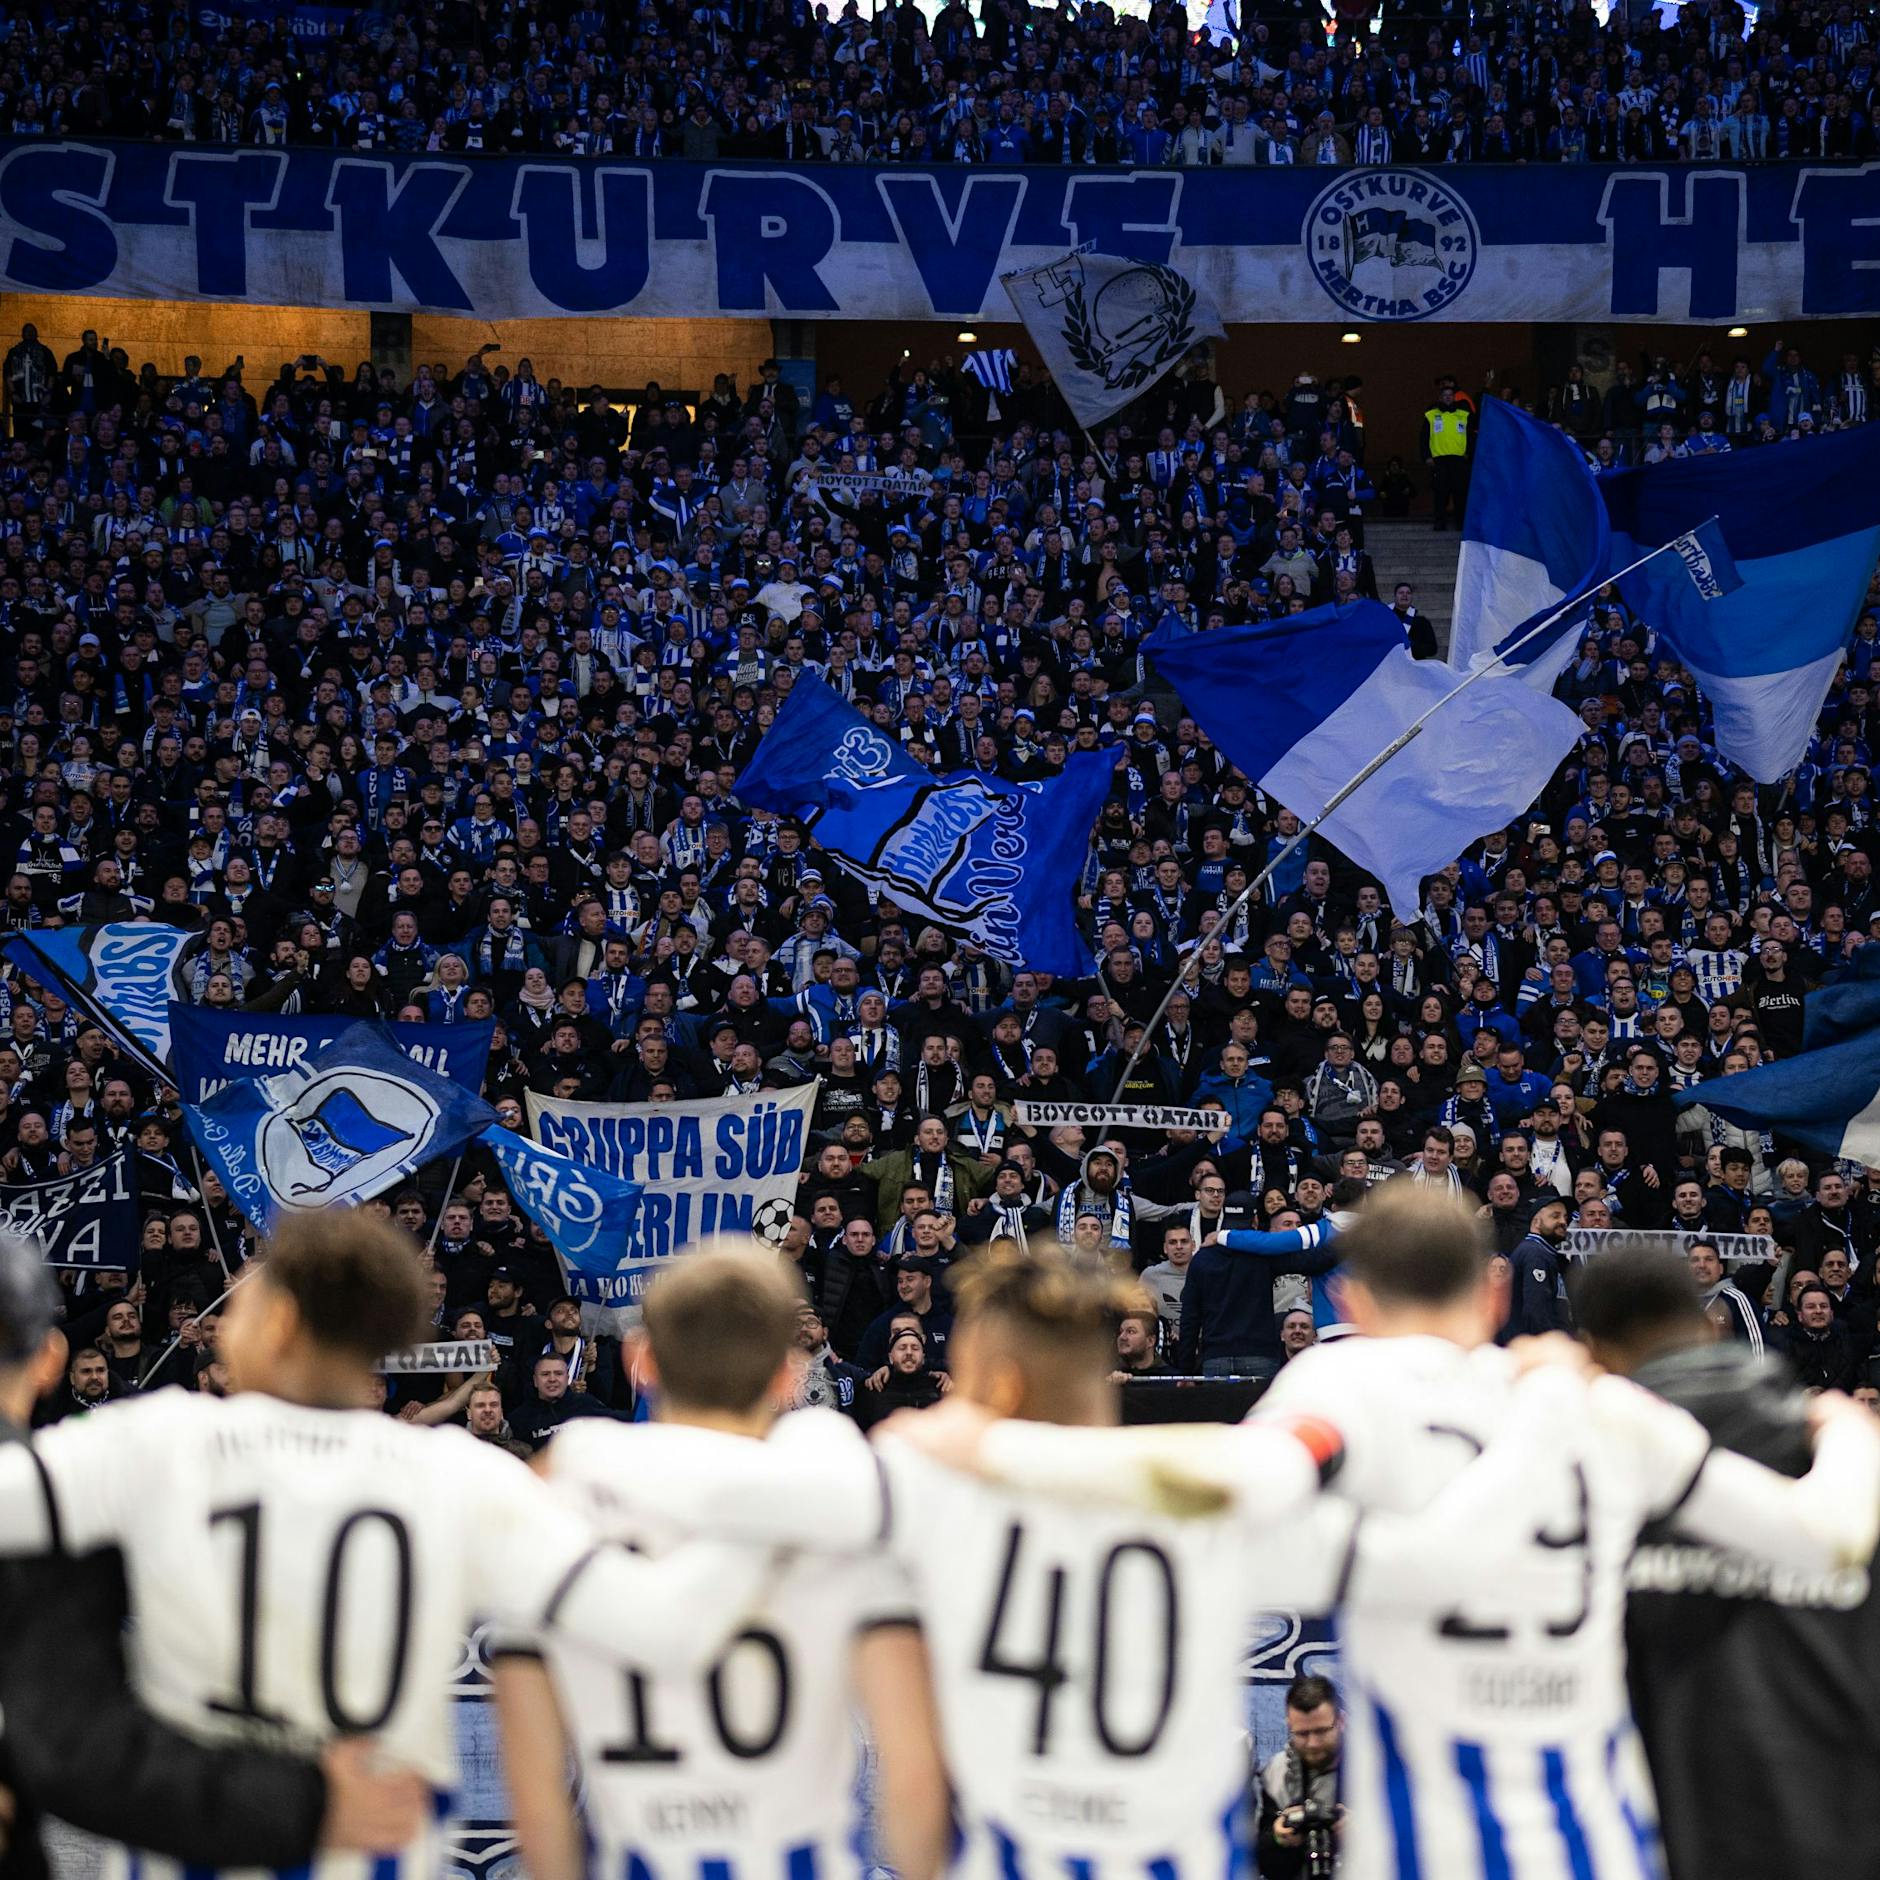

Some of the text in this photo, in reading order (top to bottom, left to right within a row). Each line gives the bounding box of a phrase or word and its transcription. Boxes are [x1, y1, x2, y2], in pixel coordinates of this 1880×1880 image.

[1320, 175, 1462, 227] OSTKURVE
[1318, 235, 1466, 252] 18 92
[1318, 259, 1467, 316] HERTHA BSC
[967, 793, 1028, 899] Vere
[1758, 993, 1801, 1008] Berlin
[223, 1032, 308, 1068] MEHR
[538, 1101, 804, 1180] GRUPPA SÜD
[1026, 1104, 1219, 1128] BOYCOTT QATAR
[0, 1154, 130, 1219] AZZI
[628, 1192, 754, 1259] ERLIN
[208, 1502, 413, 1733] 10
[979, 1520, 1178, 1758] 40
